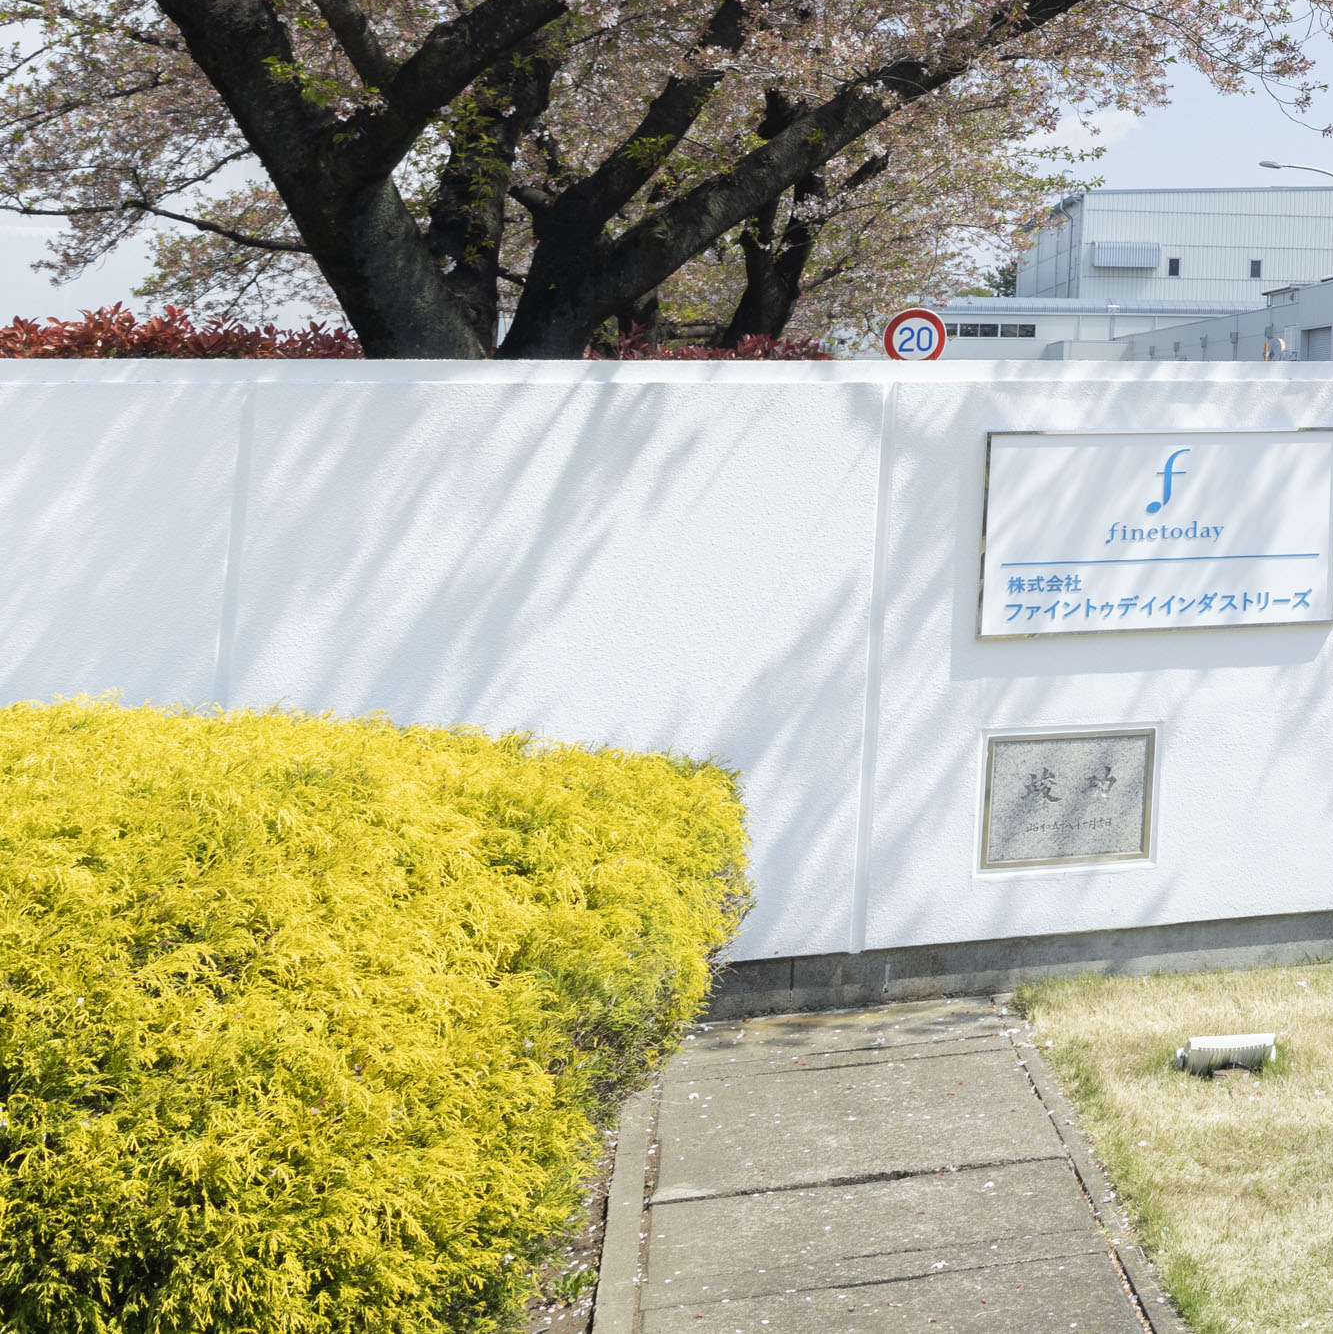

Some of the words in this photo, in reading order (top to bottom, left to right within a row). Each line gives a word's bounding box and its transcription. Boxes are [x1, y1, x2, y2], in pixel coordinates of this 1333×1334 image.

[898, 326, 933, 352] 20
[1104, 520, 1225, 545] finetoday
[1007, 574, 1082, 595] 株式会社
[1003, 588, 1314, 622] ファイントゥデイインダストリーズ
